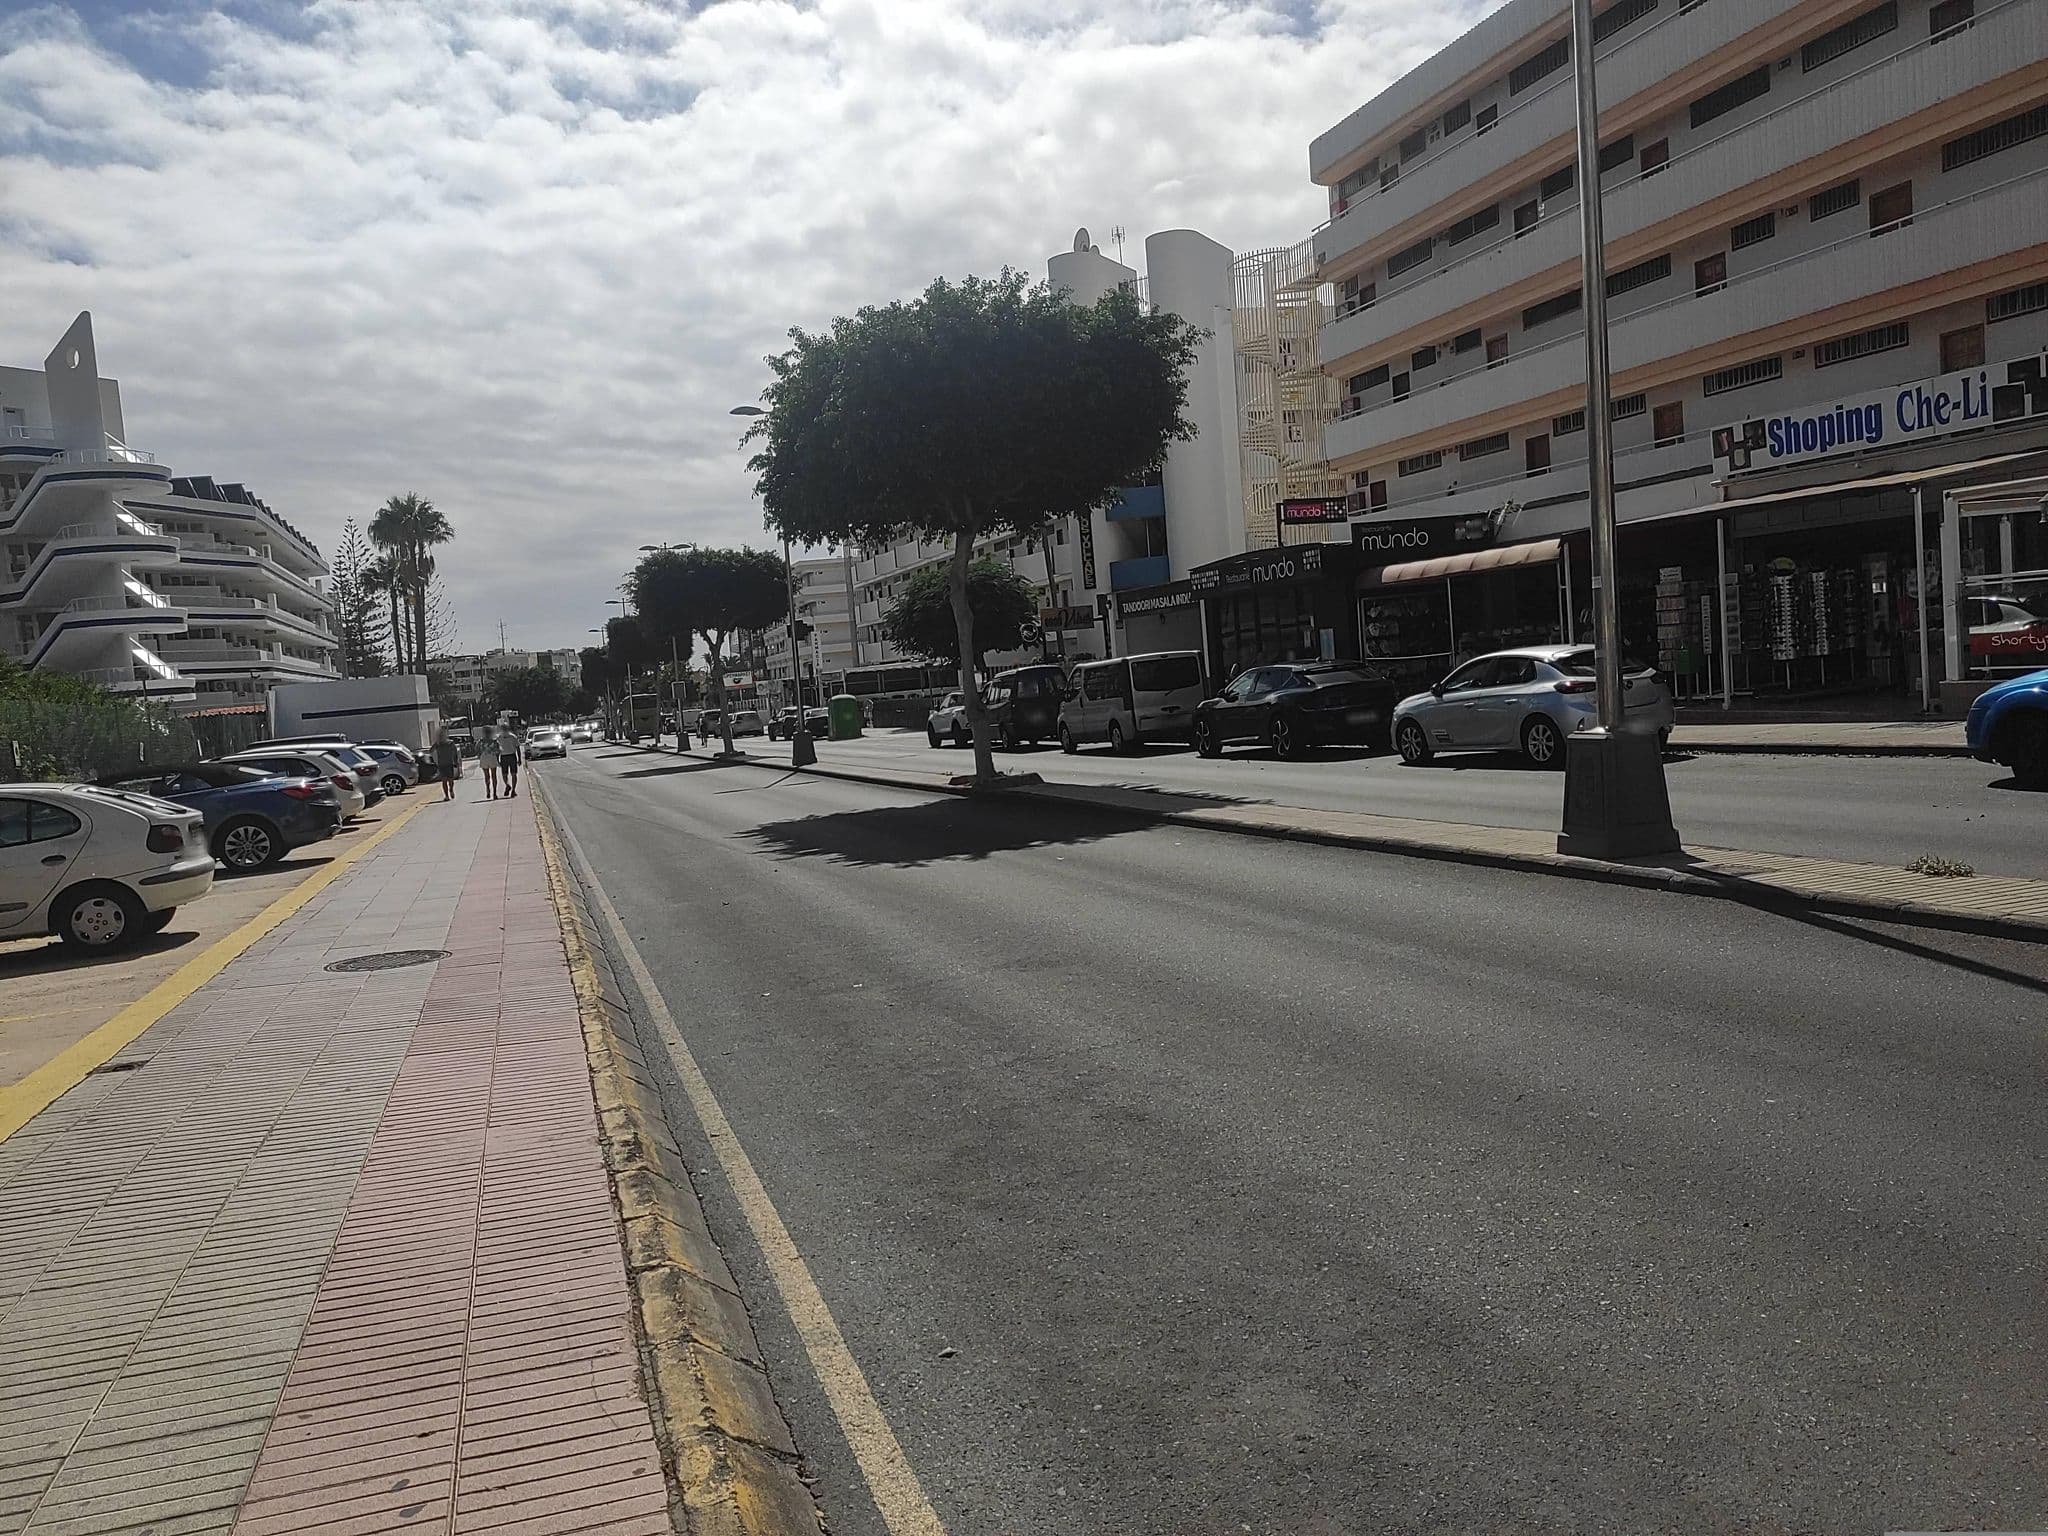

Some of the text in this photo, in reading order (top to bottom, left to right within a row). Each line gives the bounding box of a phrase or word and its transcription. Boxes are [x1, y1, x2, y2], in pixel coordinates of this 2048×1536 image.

[1767, 371, 1990, 458] Shoping Che-Li
[1286, 506, 1321, 518] mundo
[1361, 526, 1429, 551] mundo
[1252, 556, 1295, 583] mundo
[1122, 600, 1151, 613] TANDOORI
[1151, 594, 1176, 609] MASALA
